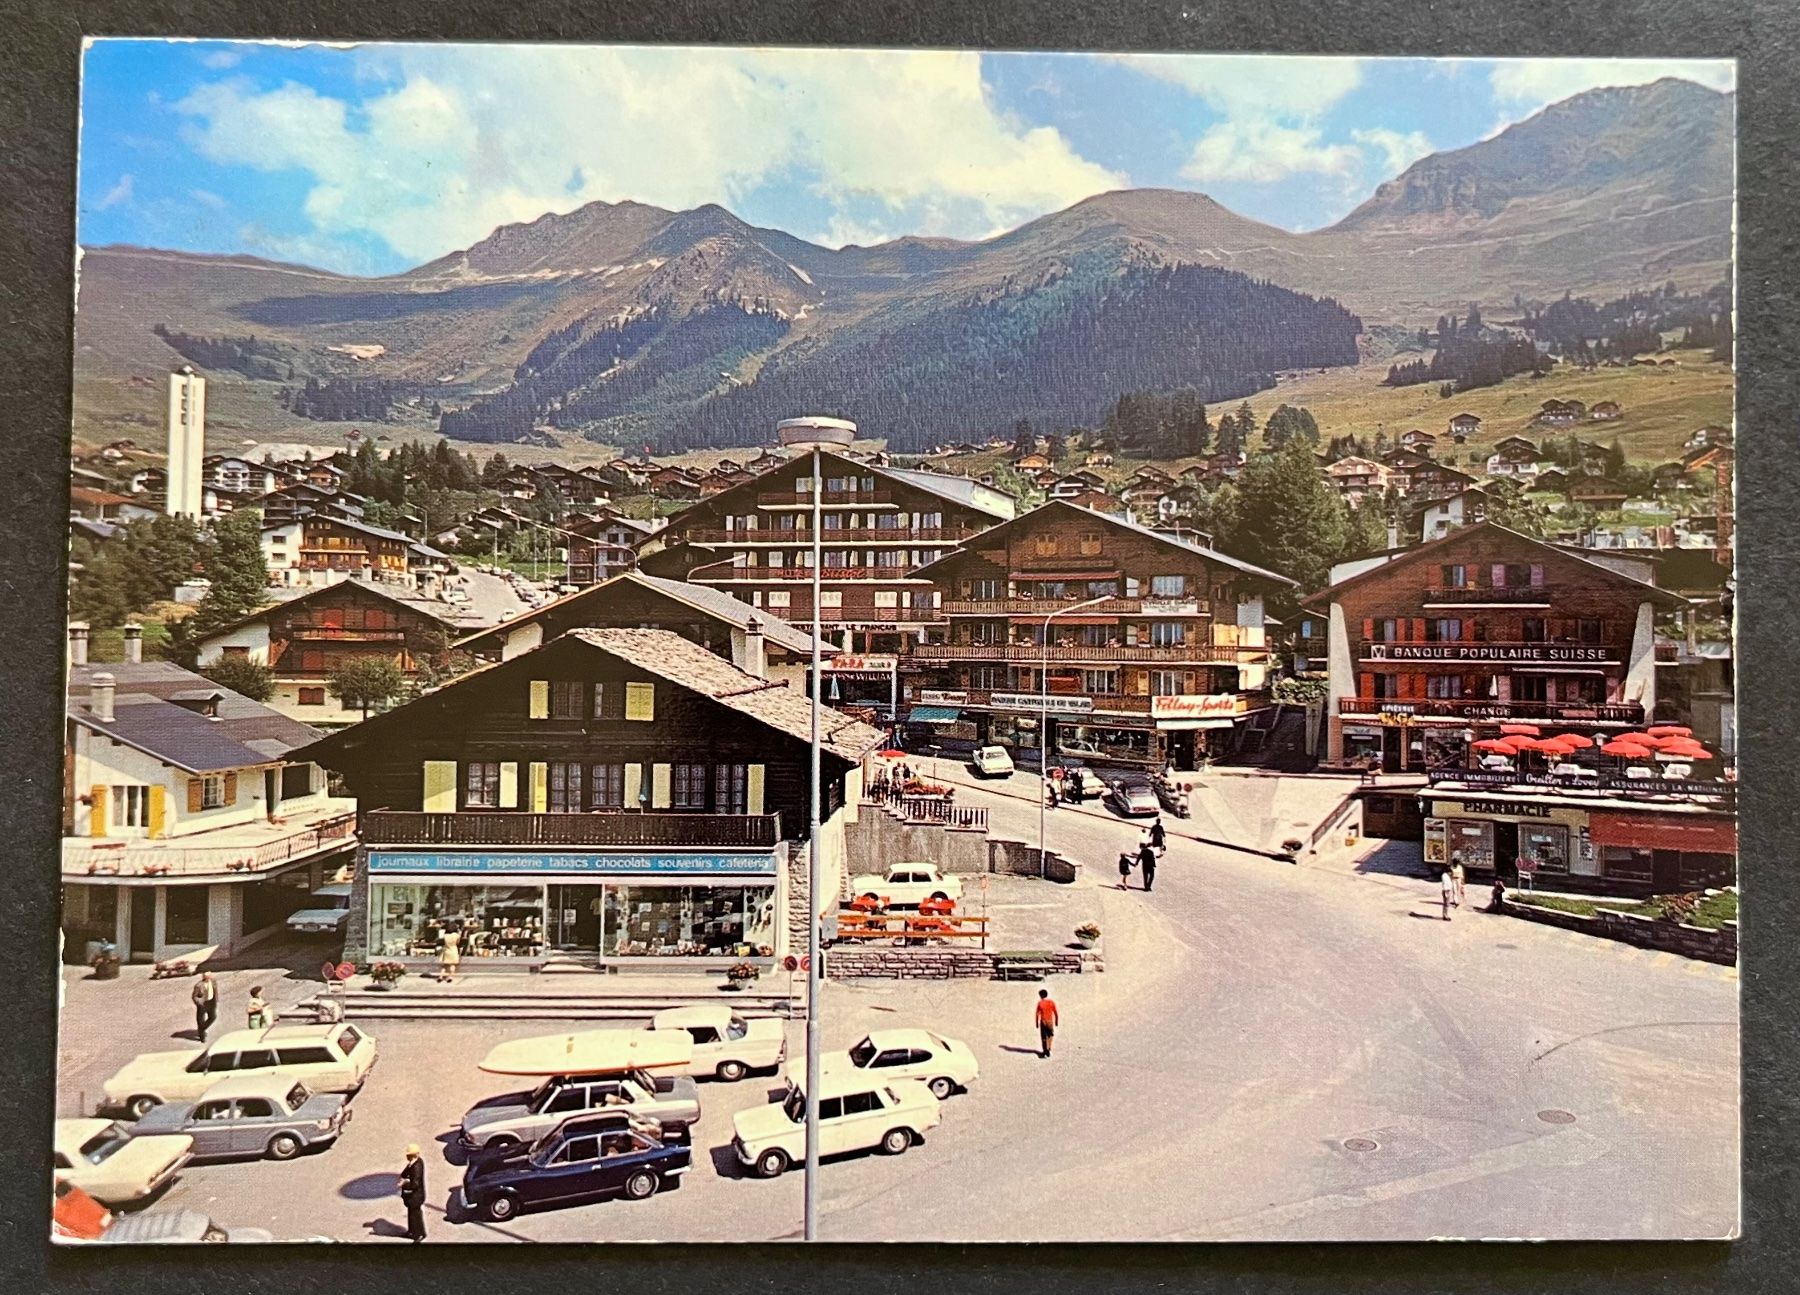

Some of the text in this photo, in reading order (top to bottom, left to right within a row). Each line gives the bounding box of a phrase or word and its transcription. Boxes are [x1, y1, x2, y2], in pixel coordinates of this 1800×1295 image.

[790, 623, 840, 631] RESTARANT
[1394, 648, 1451, 658] BANQUE
[1459, 648, 1541, 659] POPULAIRE
[1549, 649, 1606, 659] SUISSE
[1464, 706, 1511, 716] CHANGE
[1430, 771, 1460, 780] AGENCE
[1611, 780, 1667, 791] ASSURANCES
[1671, 784, 1682, 792] LA
[1464, 801, 1552, 817] PHARMACIE
[377, 855, 429, 868] journaux
[436, 855, 480, 867] librairie
[487, 856, 543, 869] papeterie
[549, 856, 589, 868] tabacs
[595, 857, 651, 868] chocolats
[658, 857, 713, 868] souvenirs
